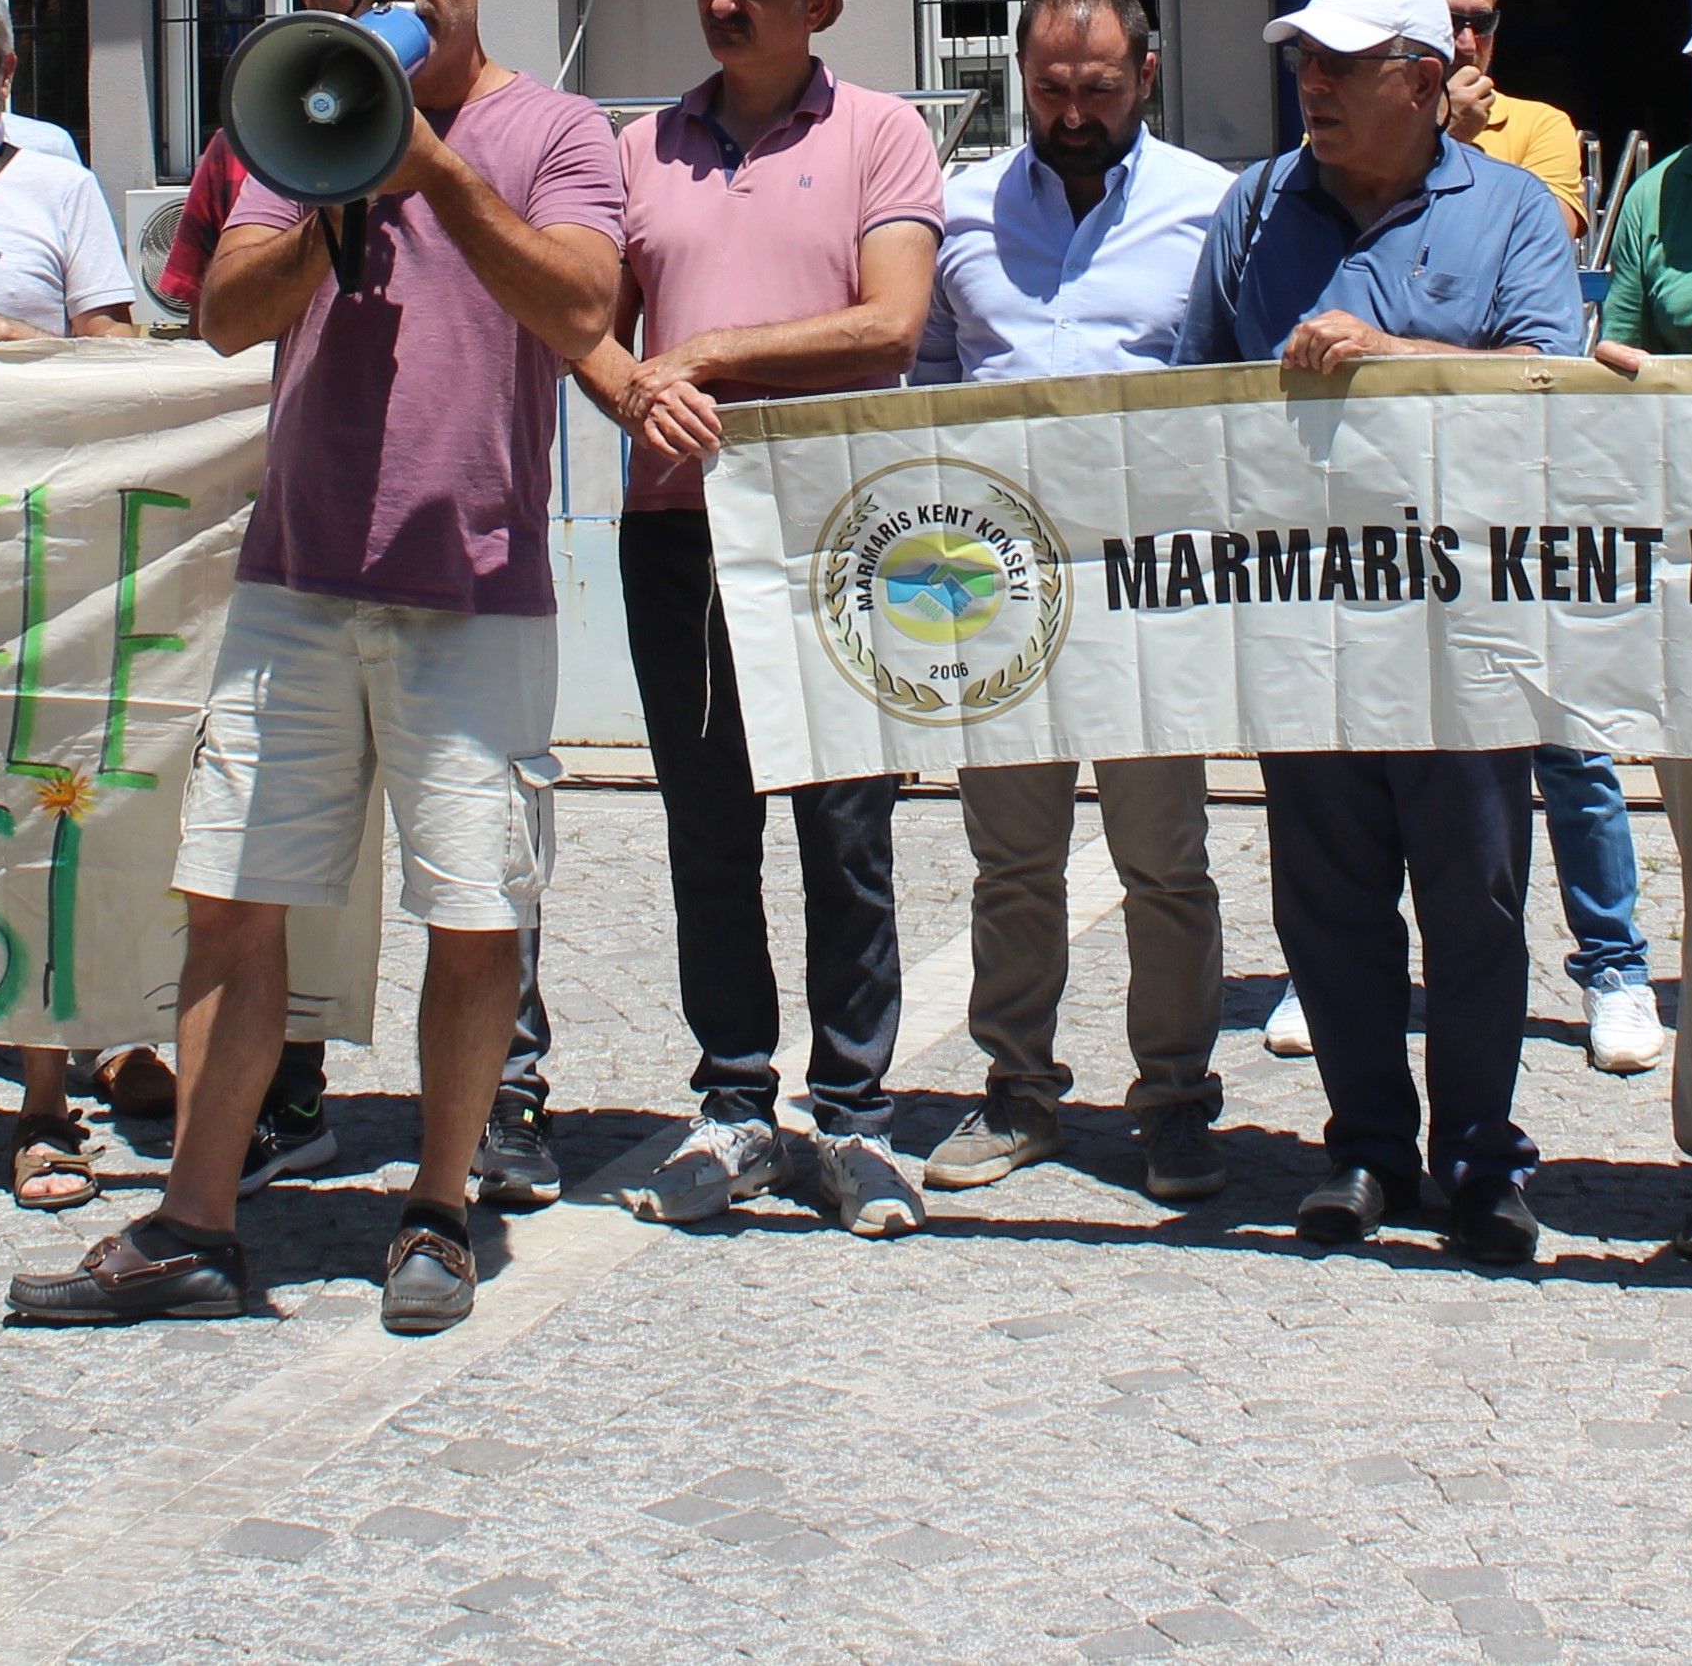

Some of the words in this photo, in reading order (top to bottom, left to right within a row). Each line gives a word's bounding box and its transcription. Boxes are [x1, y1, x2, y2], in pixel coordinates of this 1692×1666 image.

[856, 511, 912, 612] MARMARİS
[917, 504, 973, 528] KENT
[975, 517, 1035, 603] KONSEYİ
[1103, 506, 1461, 611] MARMARİS
[1489, 525, 1663, 604] KENT
[928, 662, 970, 680] 2006
